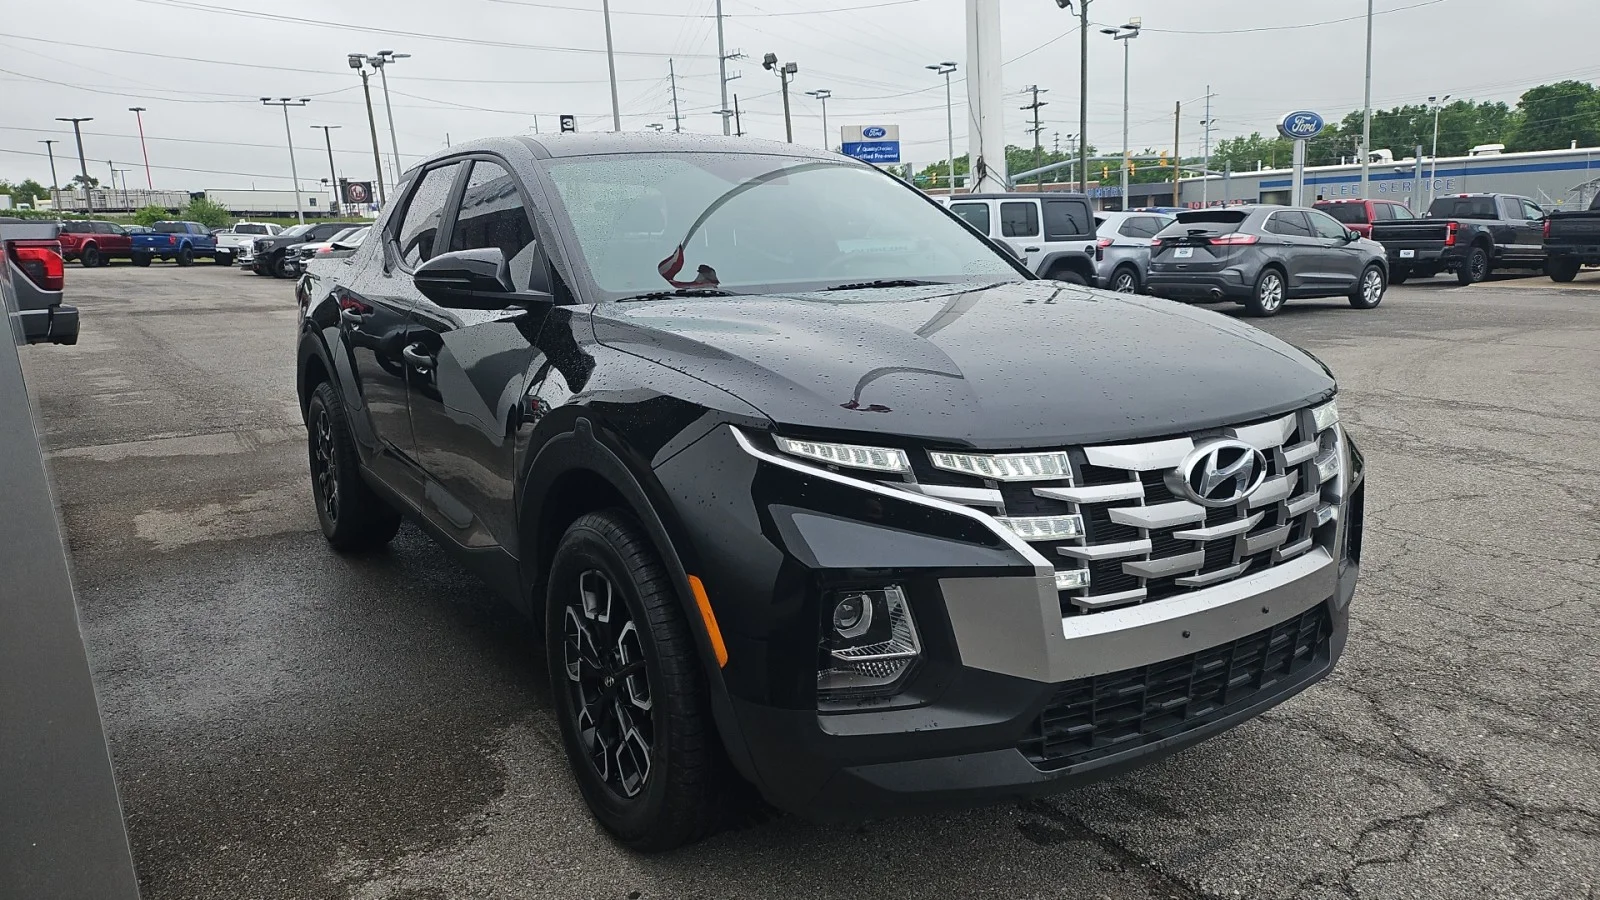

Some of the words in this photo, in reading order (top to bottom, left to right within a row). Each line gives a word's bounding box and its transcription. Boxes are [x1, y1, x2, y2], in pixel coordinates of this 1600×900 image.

[562, 118, 574, 129] 3
[1292, 116, 1317, 132] Ford
[868, 128, 883, 137] Ford
[1320, 184, 1368, 196] FLEE
[1379, 179, 1456, 194] SERICE
